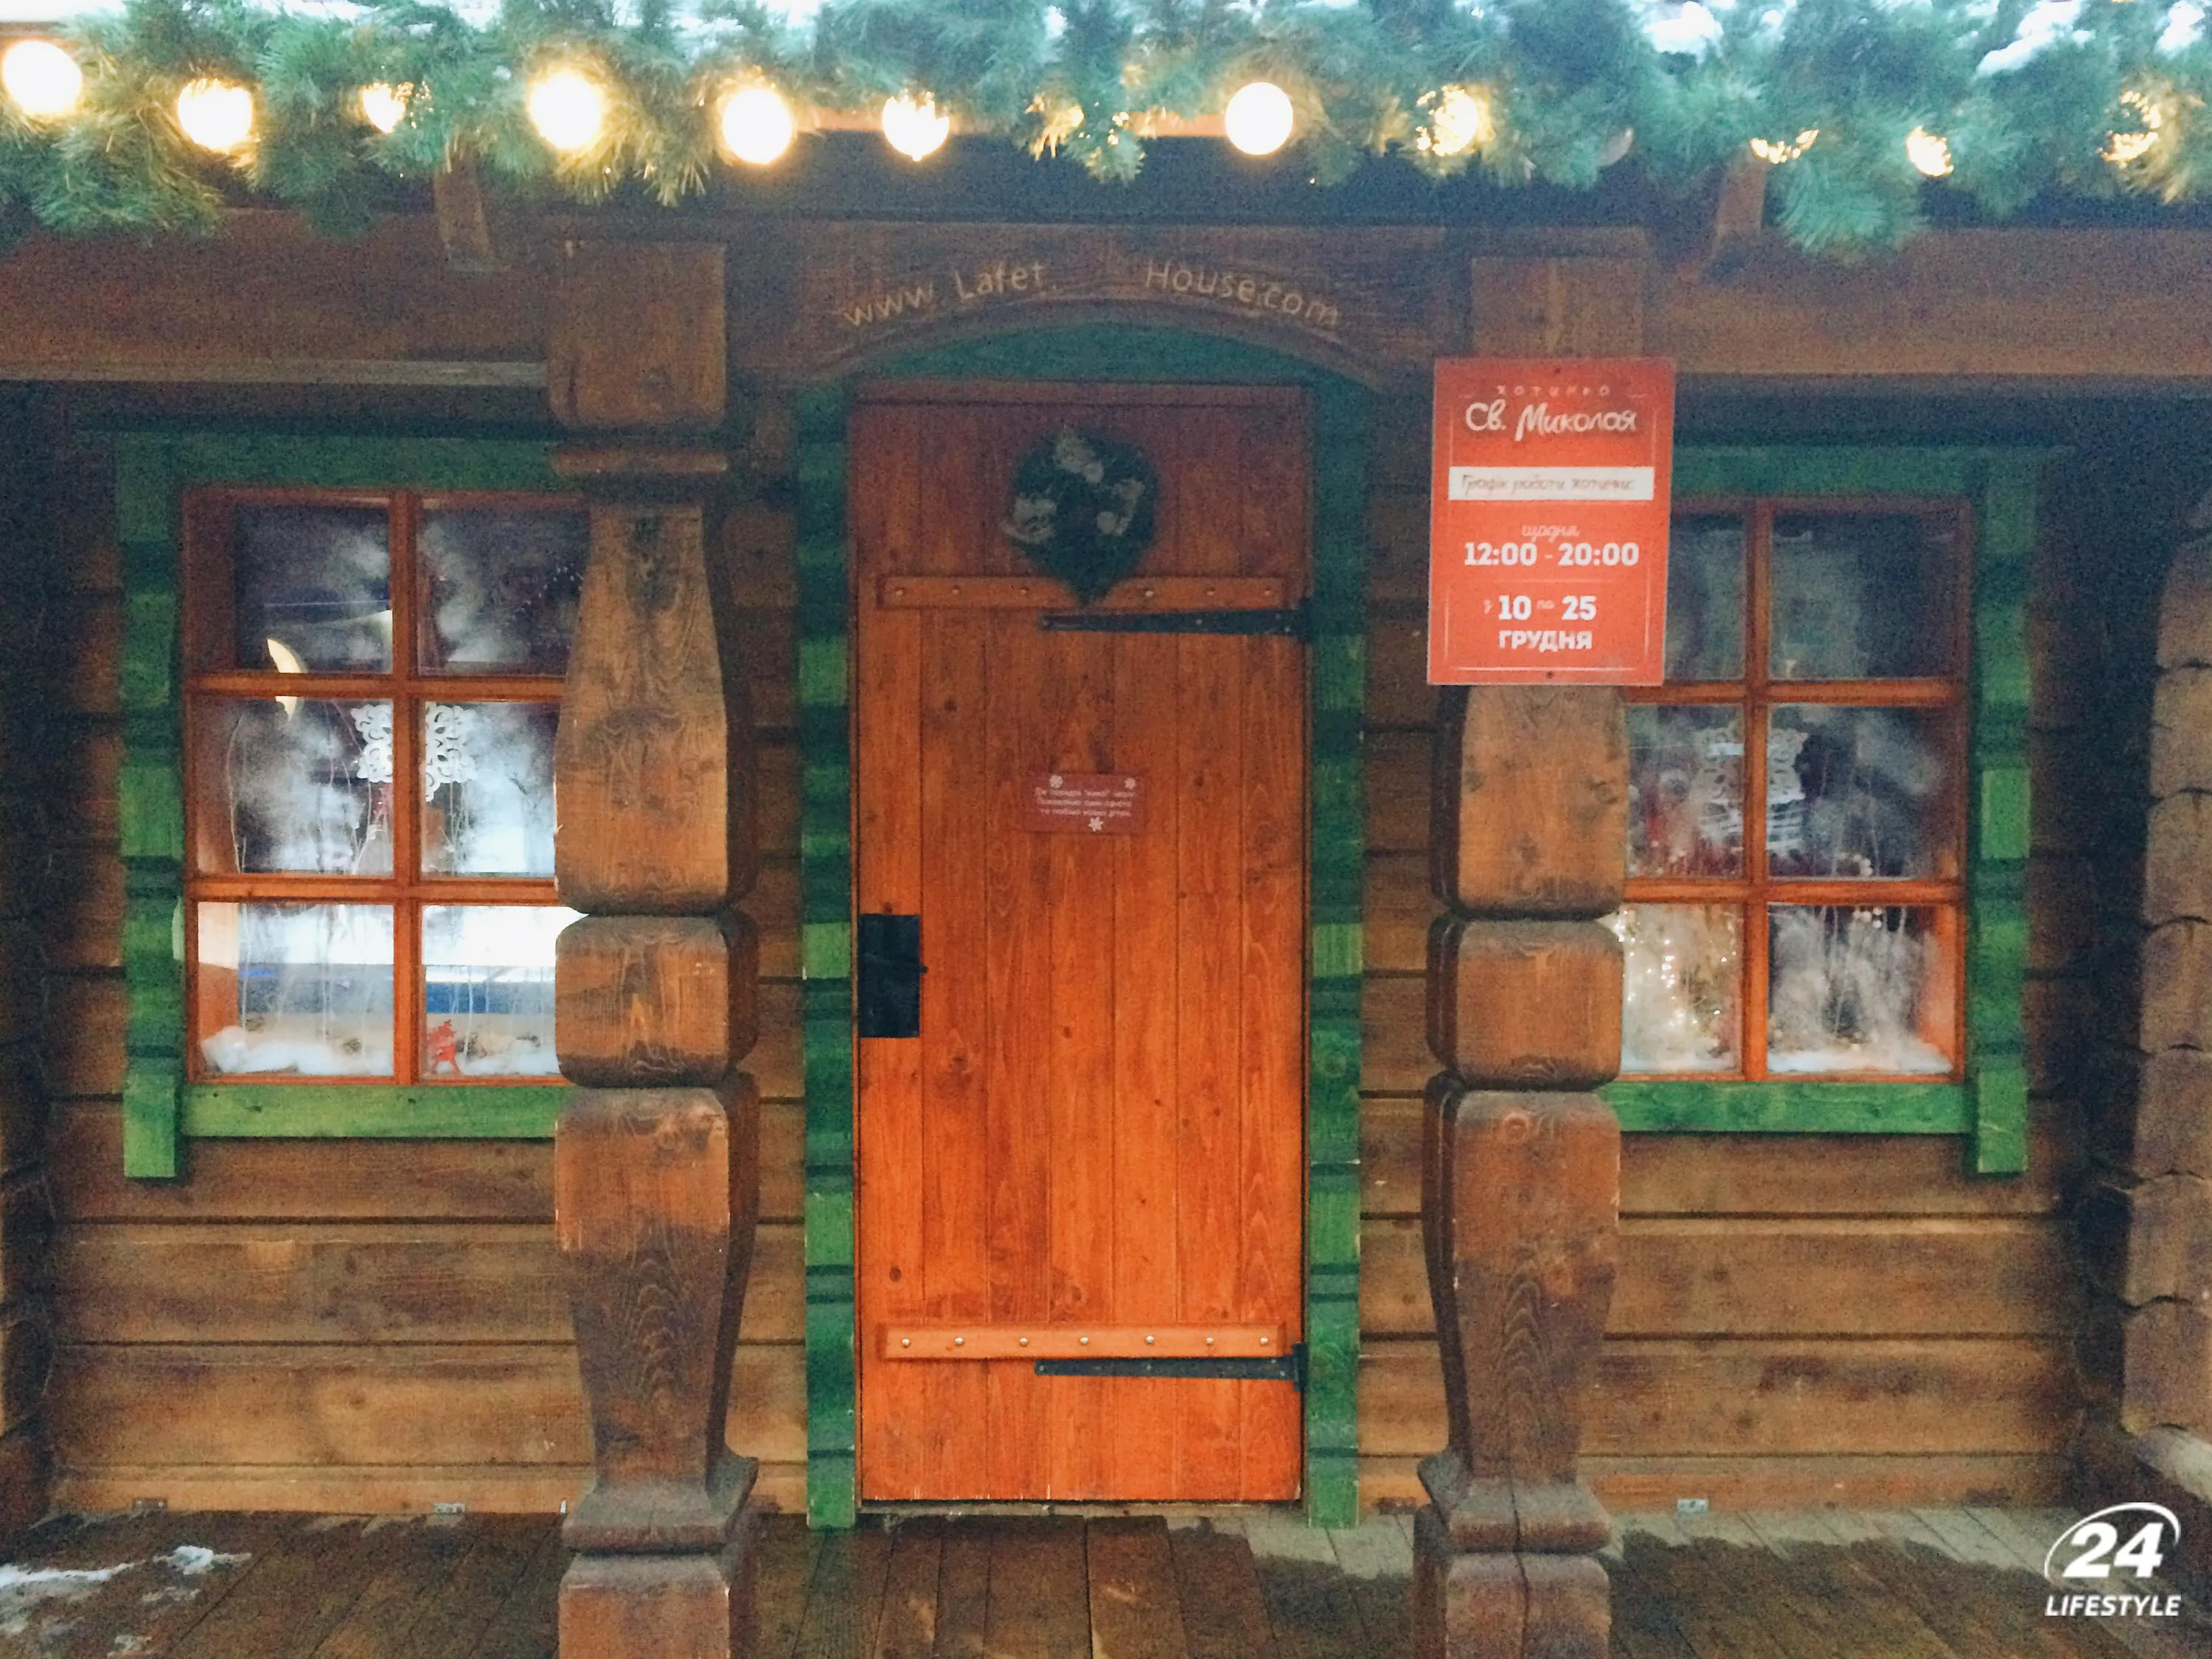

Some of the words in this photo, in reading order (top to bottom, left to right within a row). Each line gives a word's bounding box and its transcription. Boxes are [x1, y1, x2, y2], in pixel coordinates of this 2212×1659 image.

[1514, 402, 1637, 442] Миколая
[1464, 542, 1538, 566] 12:00
[1557, 542, 1640, 566] 20:00
[1498, 595, 1532, 621] 10
[1561, 595, 1597, 621] 25
[1498, 630, 1593, 653] ГРУДНЯ
